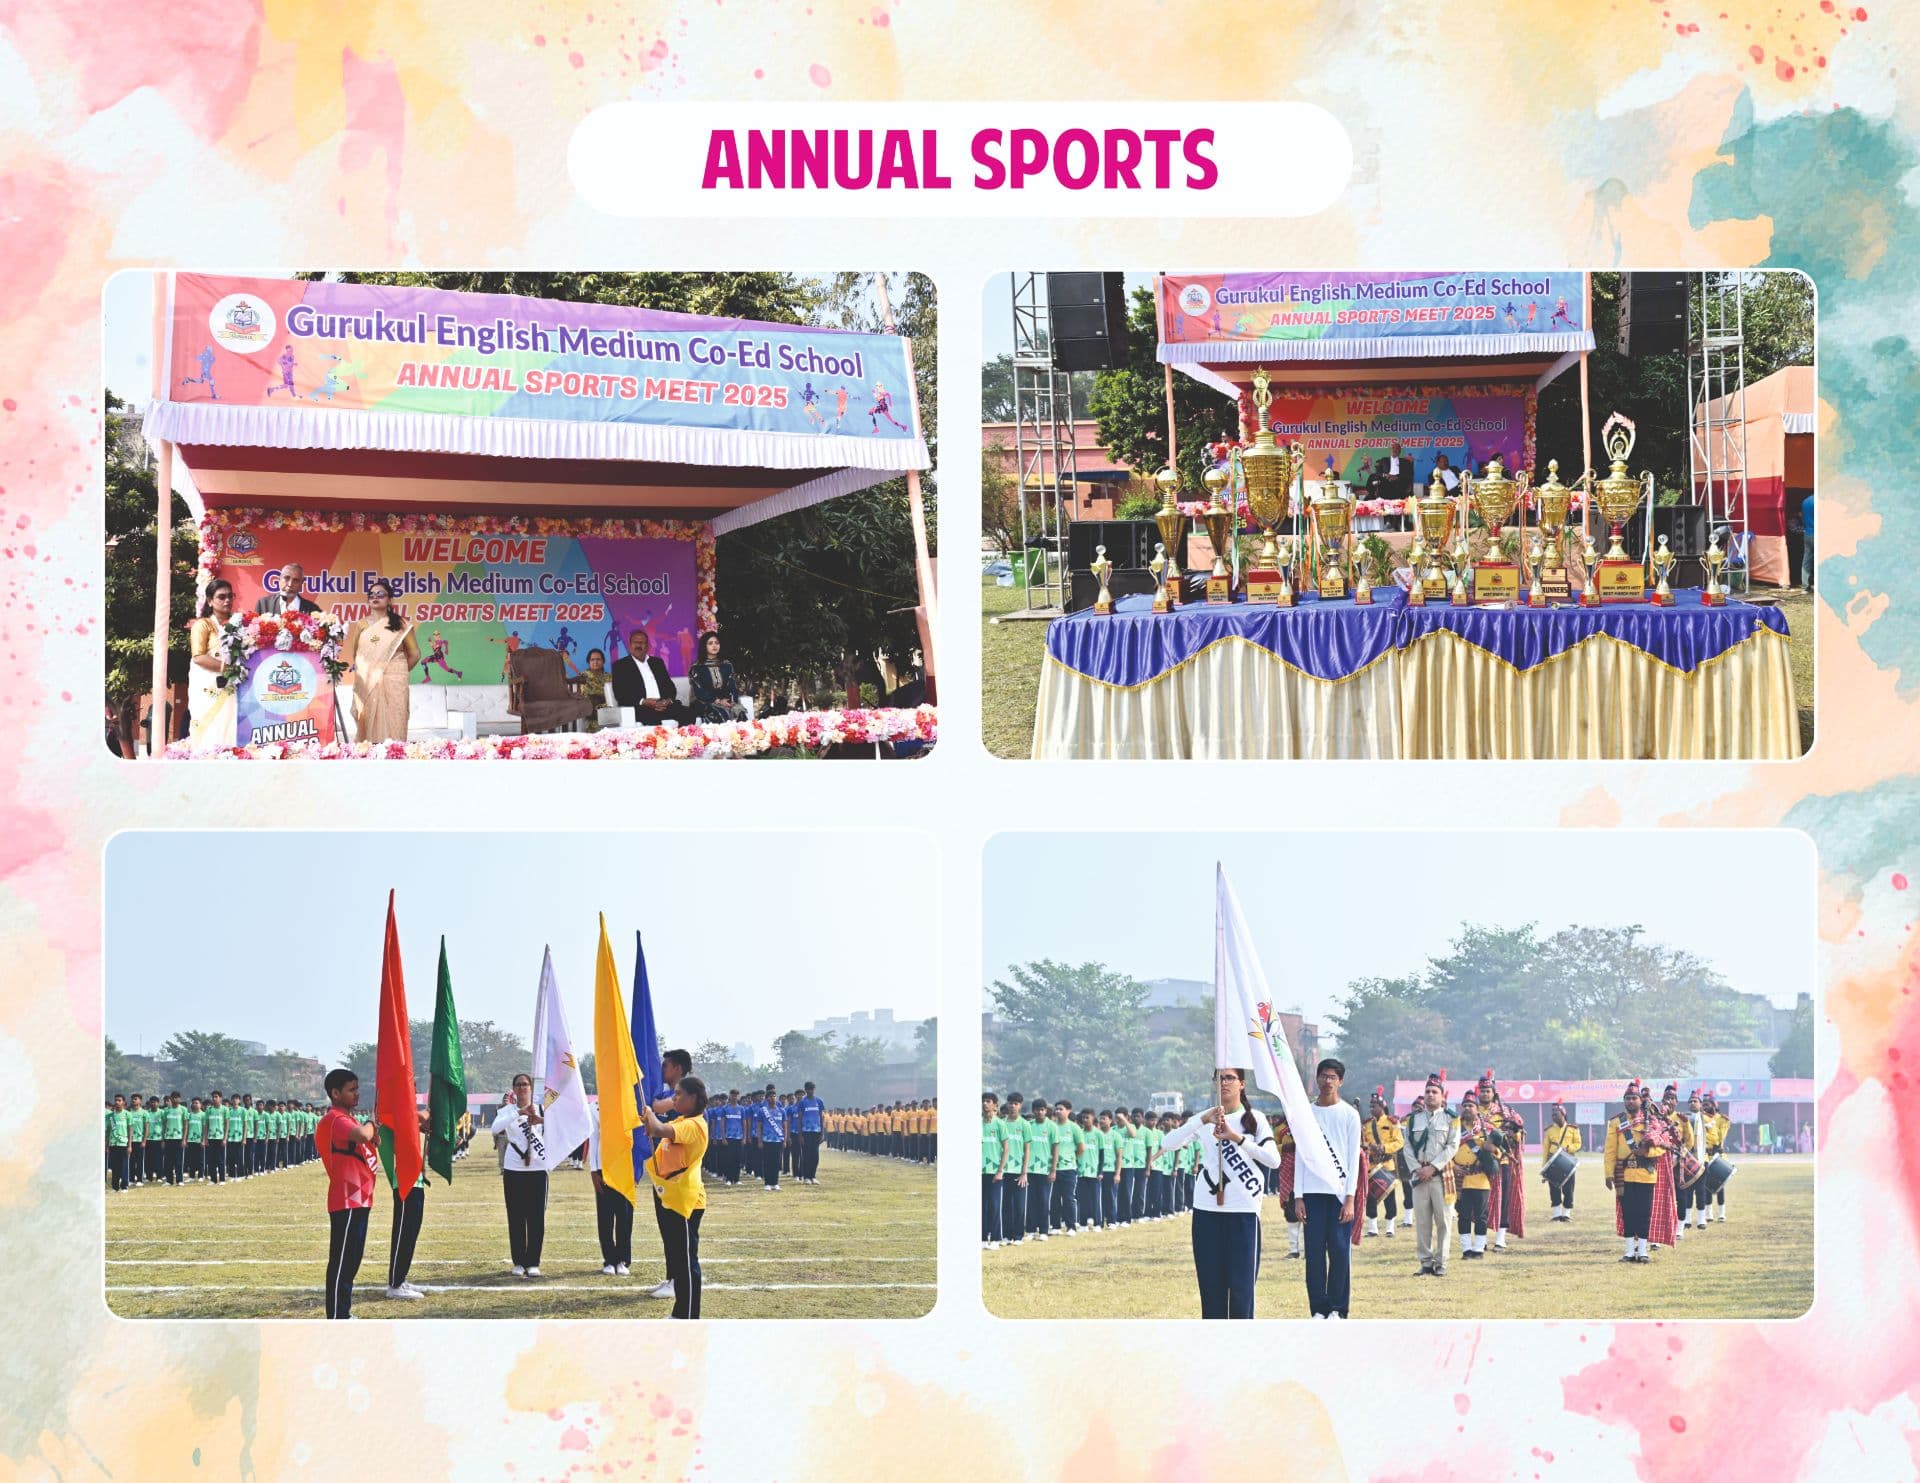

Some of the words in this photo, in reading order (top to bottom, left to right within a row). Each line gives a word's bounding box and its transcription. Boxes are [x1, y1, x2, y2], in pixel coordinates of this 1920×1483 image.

[1216, 286, 1285, 304] Gurukul
[1291, 283, 1350, 304] English
[1357, 281, 1428, 299] Medium
[1434, 279, 1486, 297] Co-Ed
[1491, 277, 1550, 296] School
[1270, 312, 1331, 326] ANNUAL
[1337, 309, 1401, 324] SPORTS
[1405, 307, 1450, 321] MEET
[1454, 306, 1496, 320] 2025
[287, 306, 425, 344] Gurukul
[437, 316, 549, 355] English
[559, 326, 681, 362] Medium
[689, 337, 771, 369] Co-Ed
[779, 344, 863, 378] School
[397, 363, 517, 392] ANNUAL
[525, 370, 637, 398] SPORTS
[645, 378, 719, 404] MEET
[724, 384, 788, 408] 2025
[1347, 400, 1430, 415] WELCOME
[1273, 421, 1321, 434] Gurukul
[1325, 420, 1367, 435] English
[1371, 419, 1421, 433] Medium
[1425, 418, 1461, 431] Co-Ed
[1465, 418, 1506, 431] School
[1307, 439, 1351, 449] ANNUAL
[1354, 438, 1398, 448] SPORTS
[1400, 437, 1432, 448] MEET
[1435, 436, 1464, 447] 2025
[404, 537, 547, 563] WELCOME
[263, 570, 357, 593] Gukul
[448, 572, 533, 593] Medium
[539, 573, 599, 593] Co-Ed
[605, 573, 669, 594] School
[332, 604, 411, 625] ANNAL
[416, 603, 494, 621] SPORTS
[499, 603, 553, 620] MEET
[556, 603, 604, 620] 2025
[252, 718, 318, 745] ANNUAL
[518, 1122, 546, 1161] PREFEC
